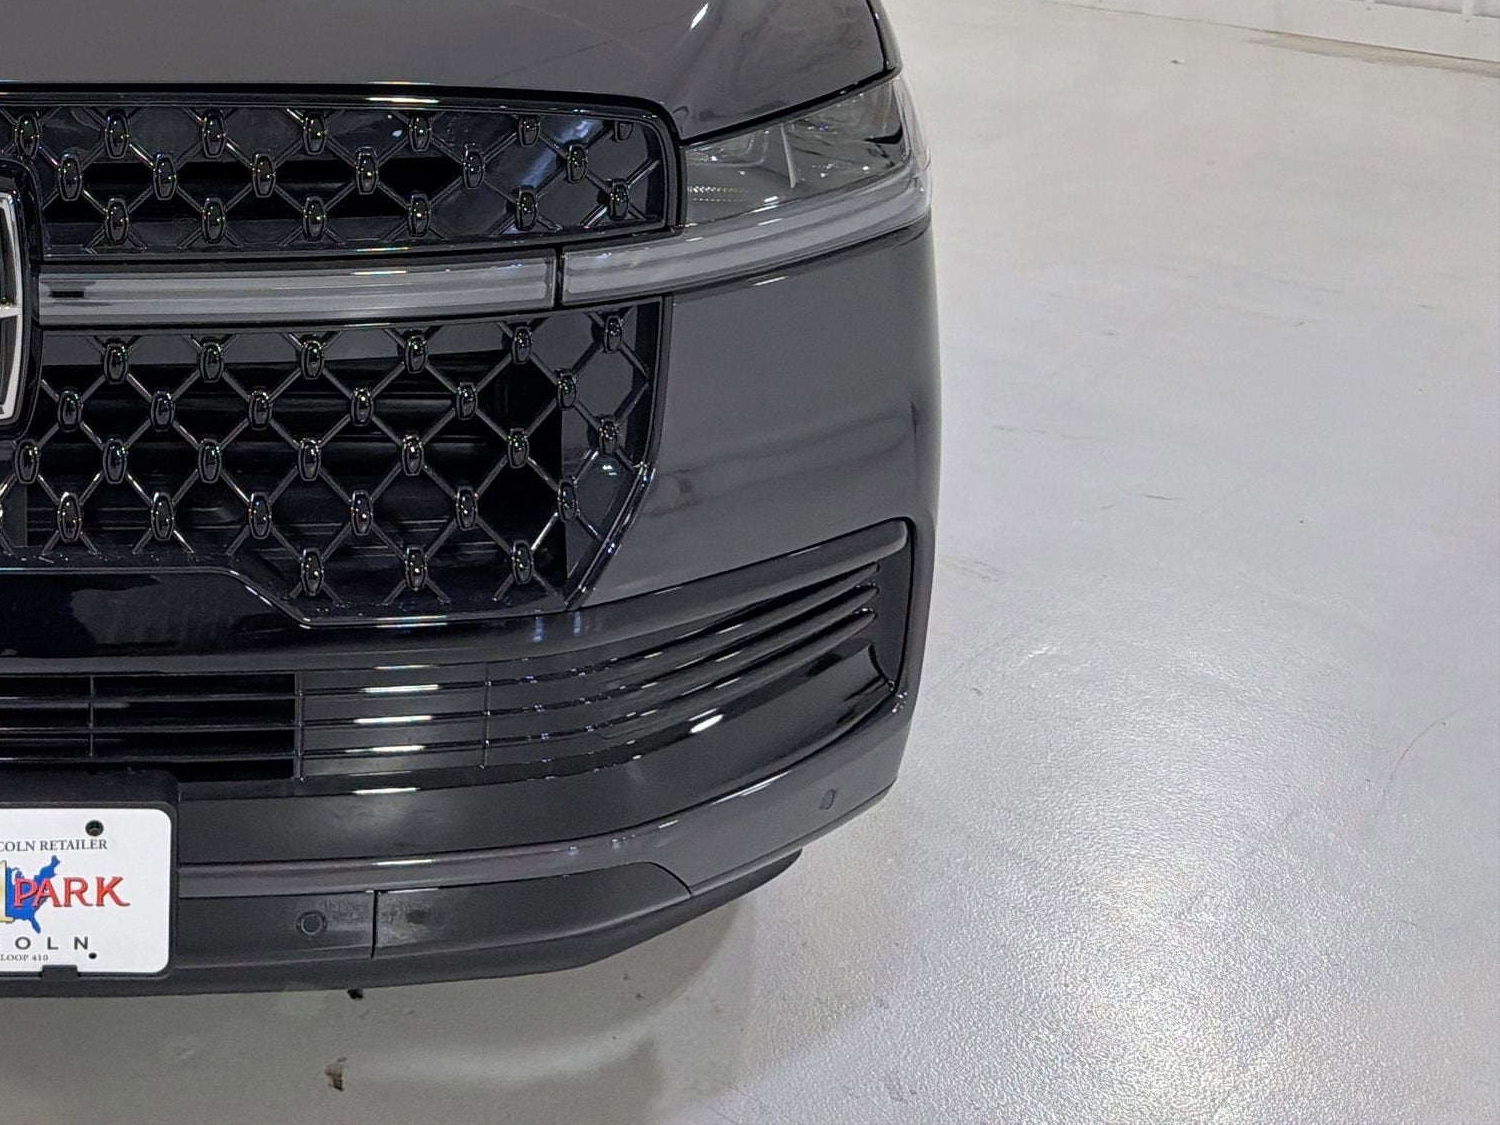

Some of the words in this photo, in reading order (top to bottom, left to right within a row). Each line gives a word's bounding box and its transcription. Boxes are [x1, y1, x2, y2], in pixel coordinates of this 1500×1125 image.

[39, 839, 108, 851] RETAILER
[14, 875, 131, 907] PARK
[0, 953, 30, 961] LOOP
[31, 953, 49, 962] 410
